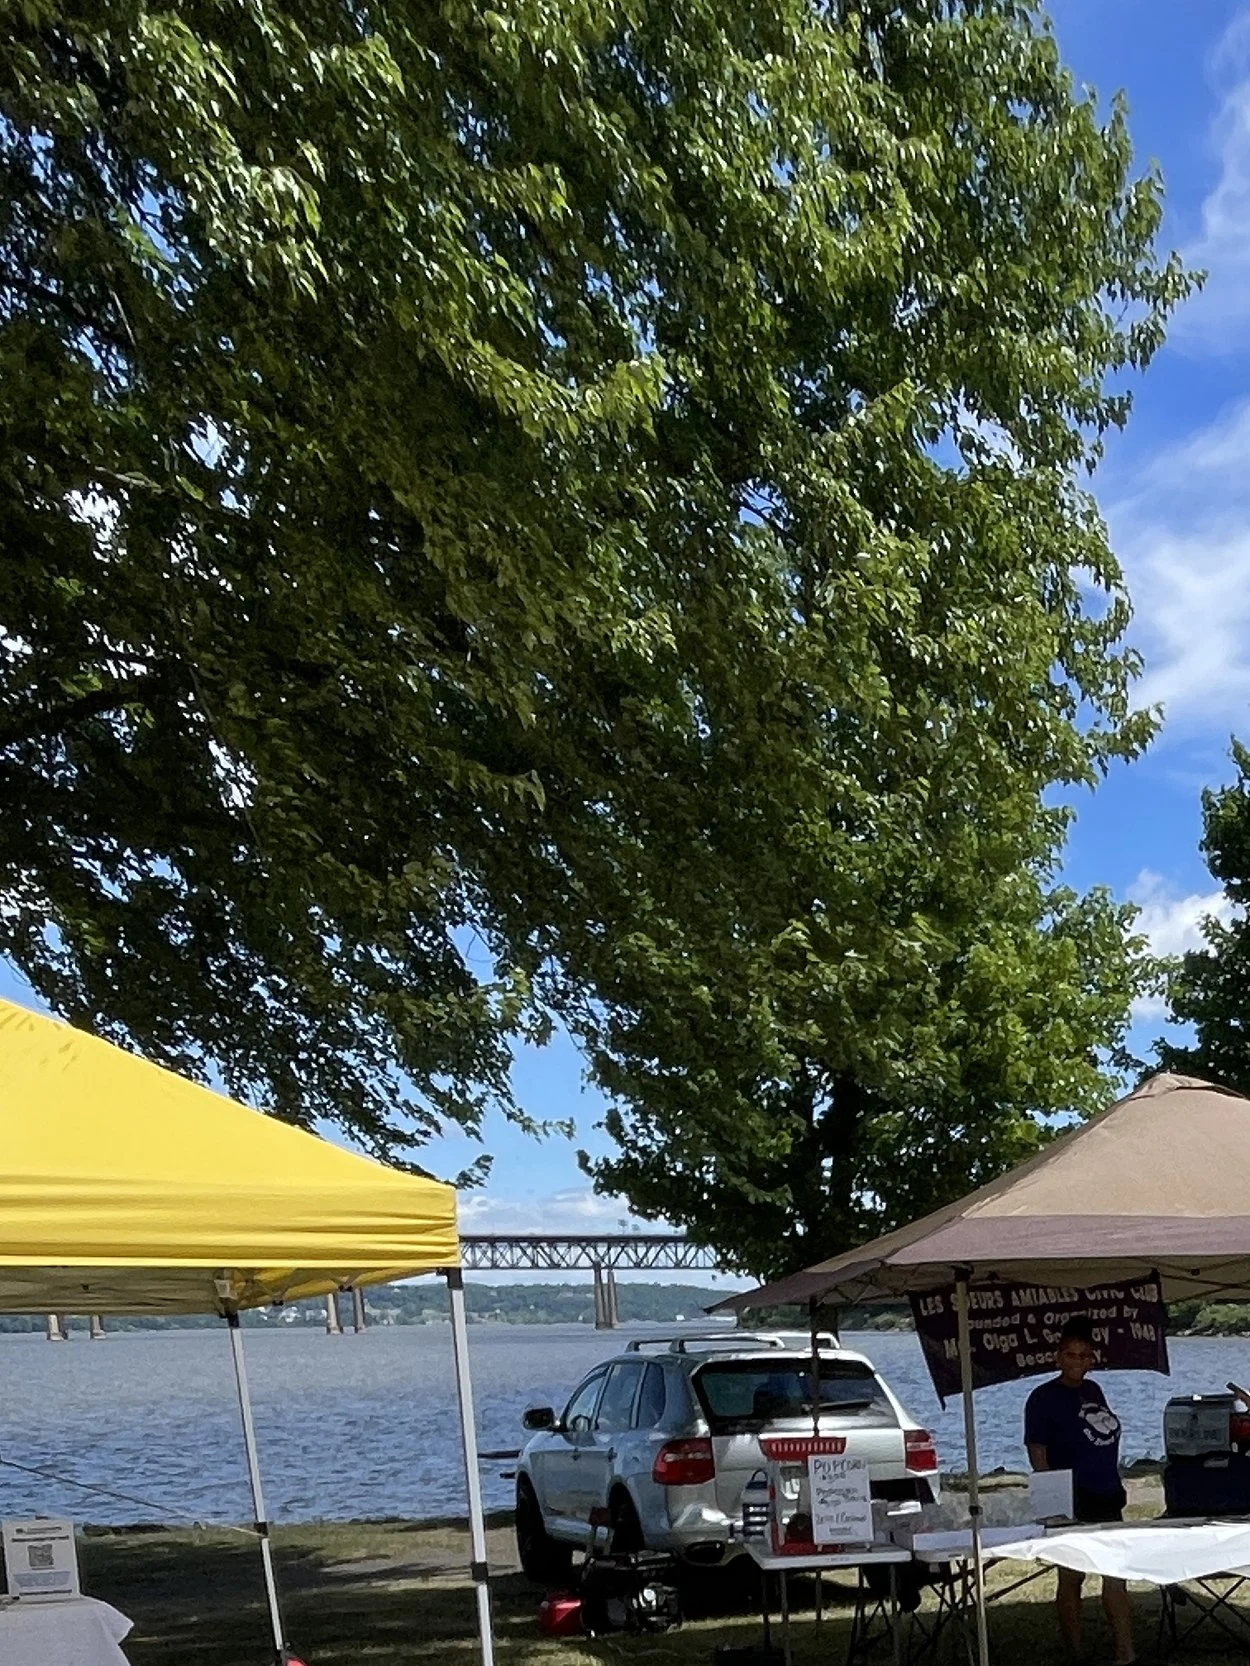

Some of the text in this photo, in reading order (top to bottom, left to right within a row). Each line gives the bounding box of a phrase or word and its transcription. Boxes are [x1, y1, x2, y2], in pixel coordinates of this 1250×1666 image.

[919, 1294, 945, 1317] LES
[950, 1289, 1004, 1312] SEURS
[1011, 1286, 1079, 1307] AMIABLES
[1129, 1283, 1159, 1303] CLUB
[1123, 1304, 1139, 1320] by
[982, 1332, 1019, 1354] Olga
